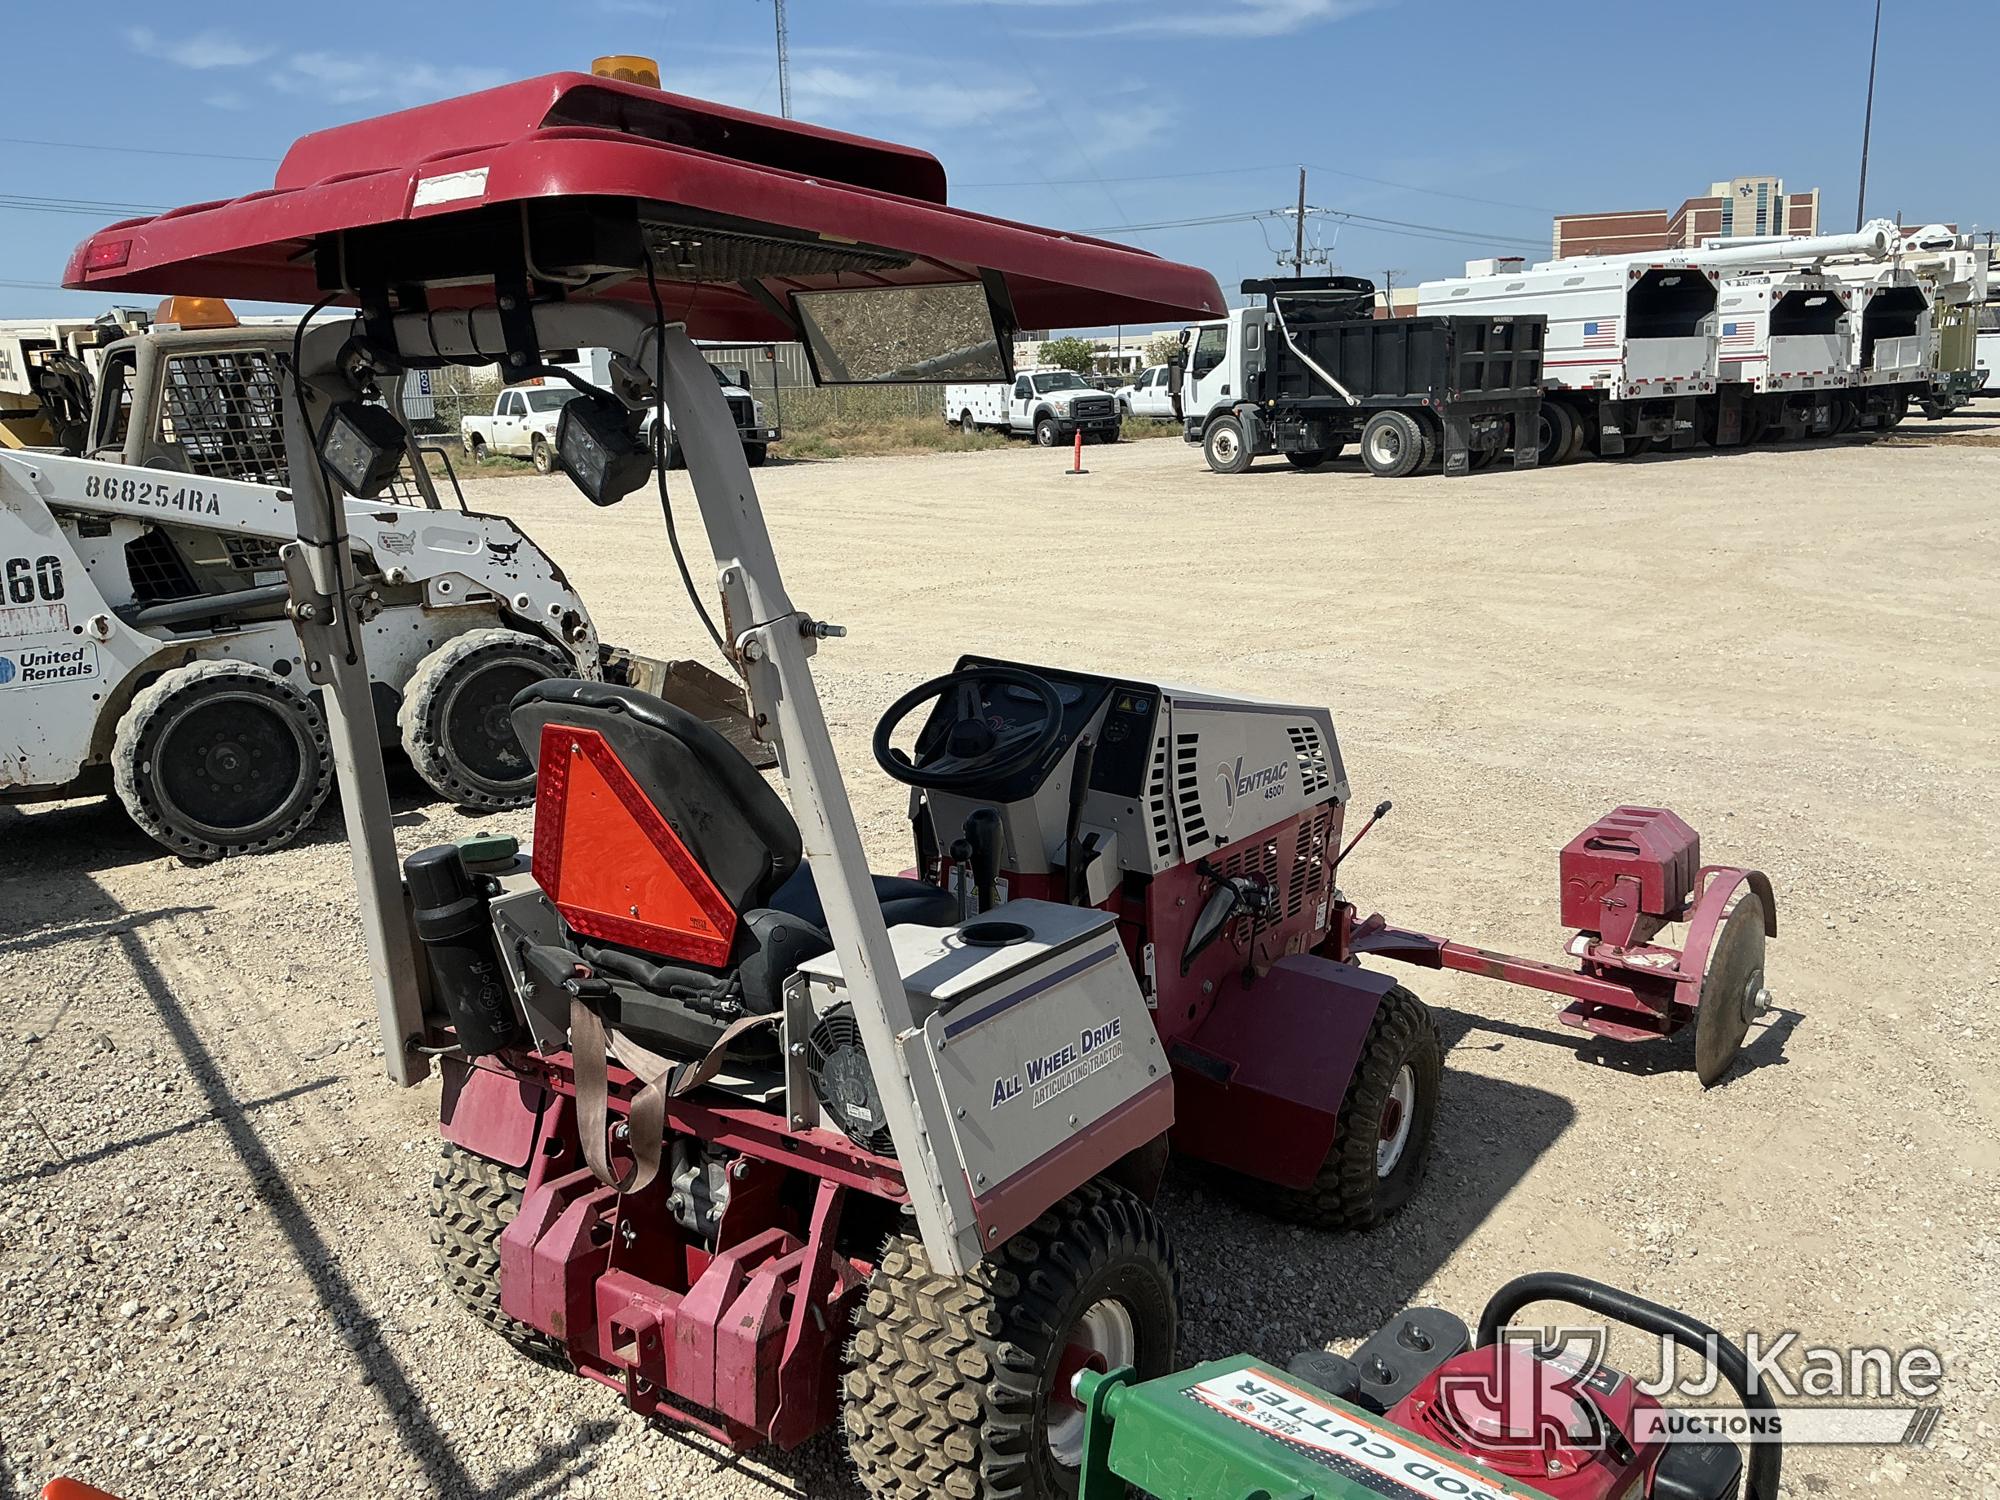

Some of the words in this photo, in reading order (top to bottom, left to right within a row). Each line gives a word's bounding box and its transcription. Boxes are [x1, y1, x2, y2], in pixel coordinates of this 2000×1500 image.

[85, 475, 221, 516] 868254RA
[20, 648, 84, 667] United
[22, 662, 93, 682] Rentals
[1215, 756, 1289, 812] VENTRAC
[1264, 785, 1285, 800] 4500Y
[991, 1077, 1023, 1110] ALL
[1025, 1044, 1078, 1087] WHEEL
[1080, 1017, 1121, 1054] DRIVE
[1033, 1060, 1088, 1109] ARTICULATING
[1089, 1041, 1124, 1073] TRACTOR
[1236, 1380, 1396, 1459] CUTTER
[1404, 1462, 1496, 1500] SOD
